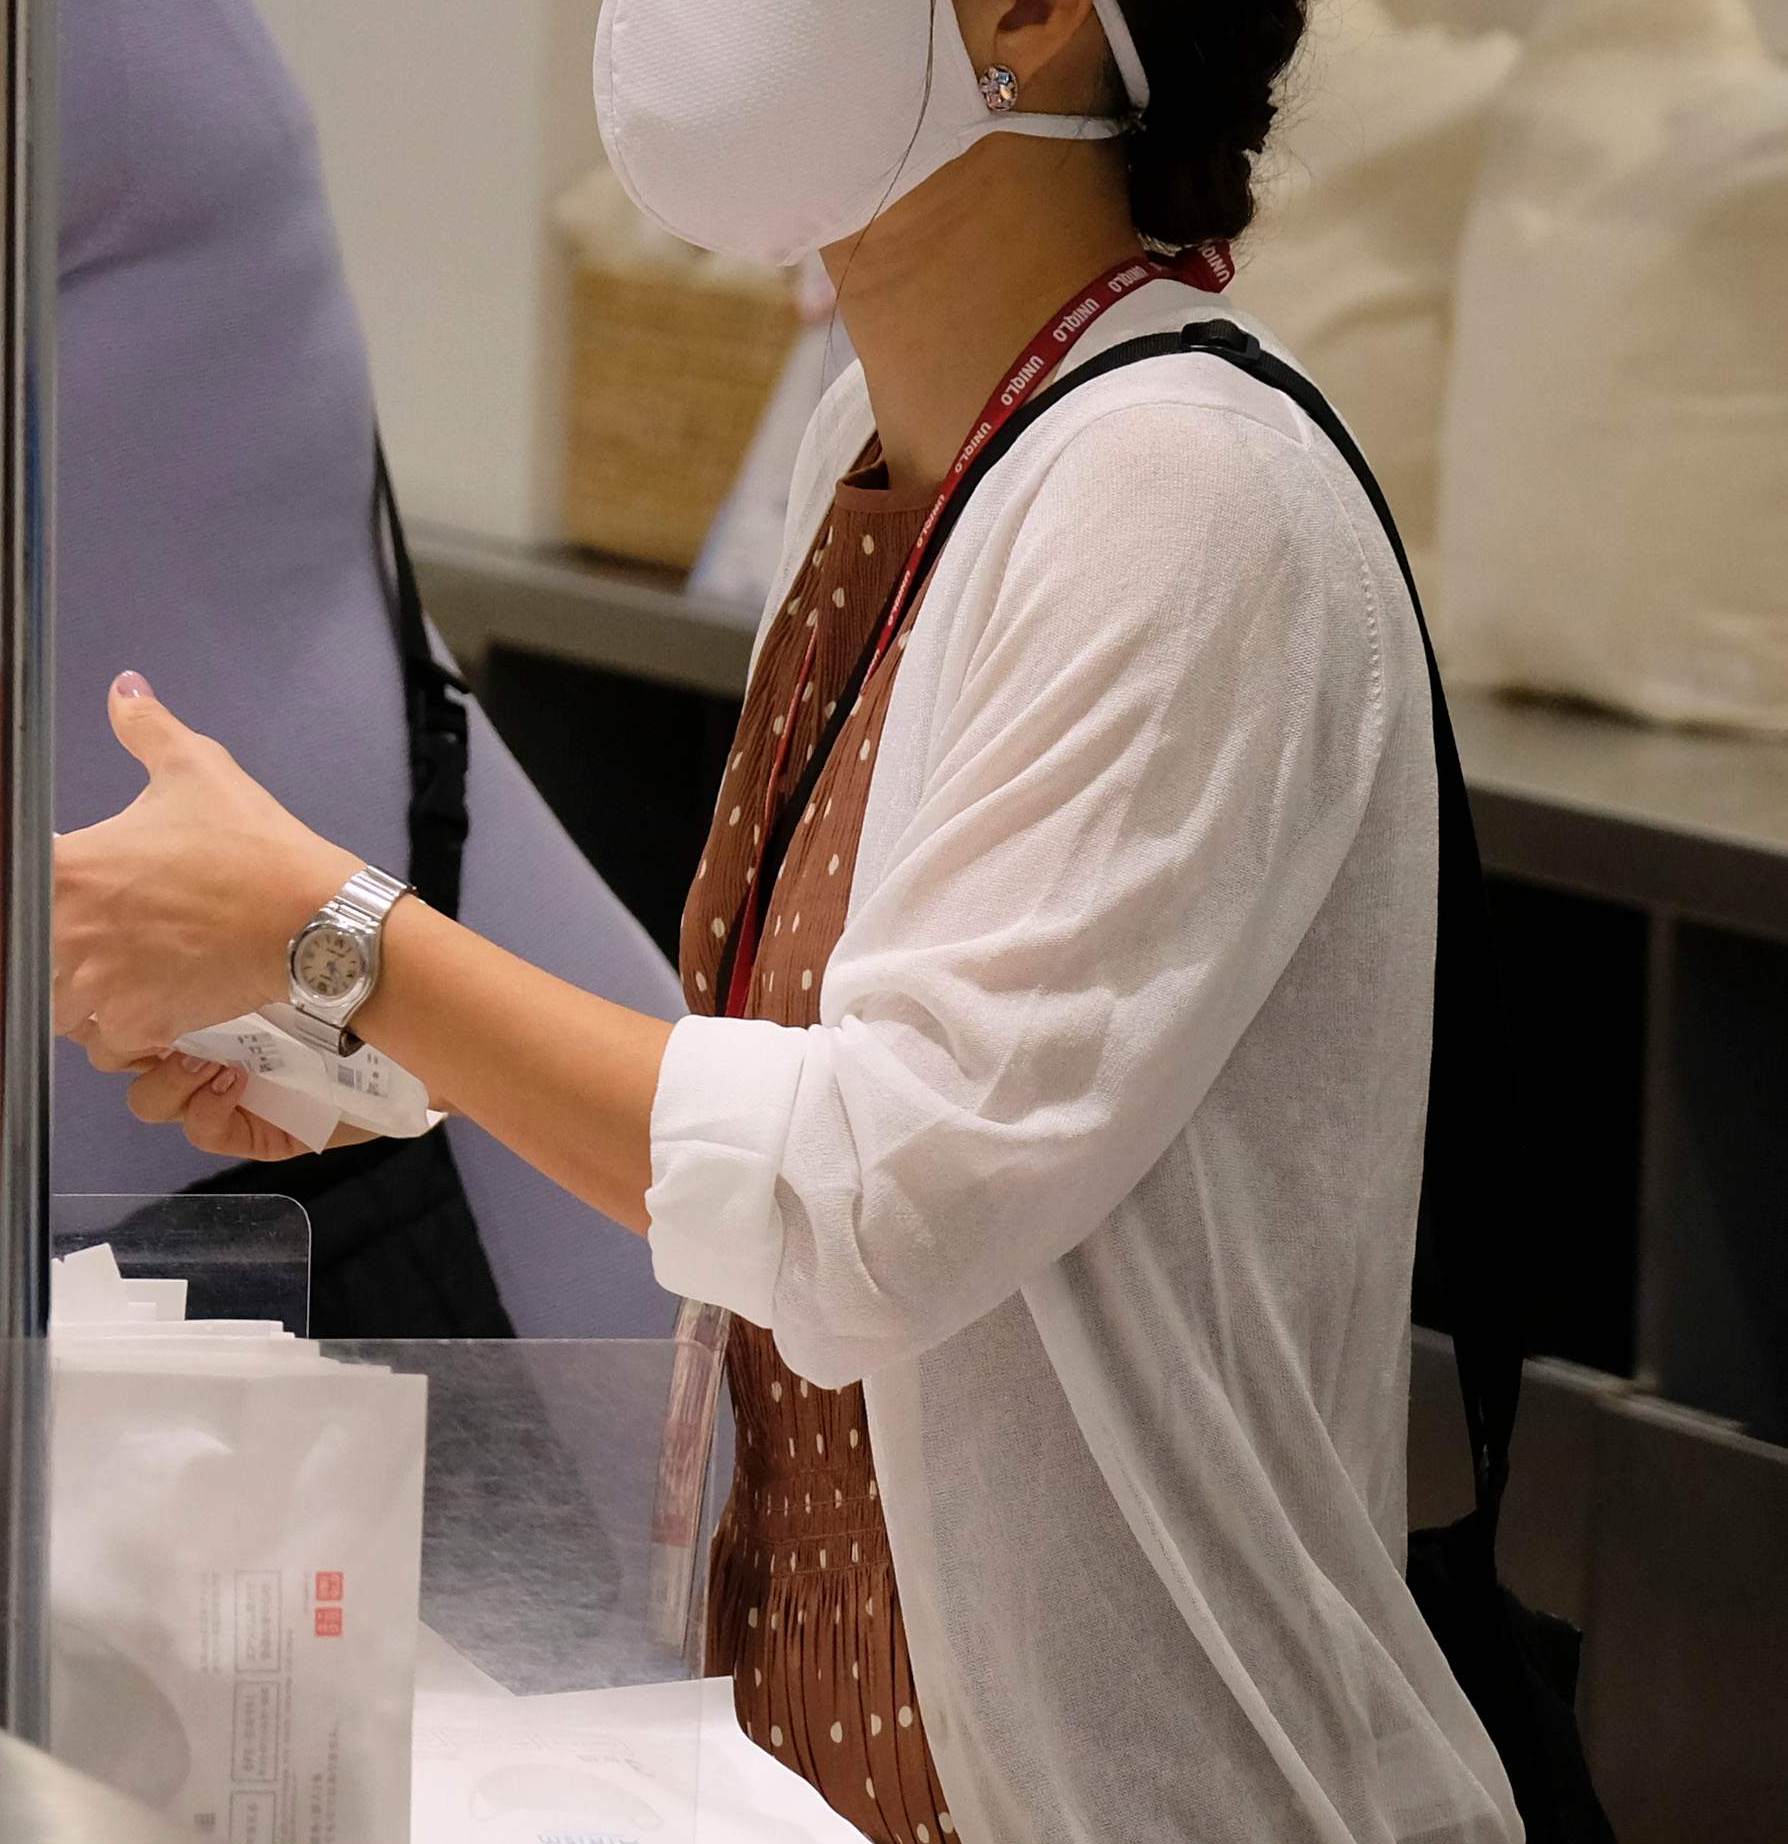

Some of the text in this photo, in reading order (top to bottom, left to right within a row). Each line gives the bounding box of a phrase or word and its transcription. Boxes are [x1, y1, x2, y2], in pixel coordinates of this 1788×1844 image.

[1198, 240, 1231, 284] UNIQ
[1052, 297, 1101, 343] UNIQLO
[1000, 355, 1045, 407] UNIQLO
[954, 421, 993, 474] UNIQLO
